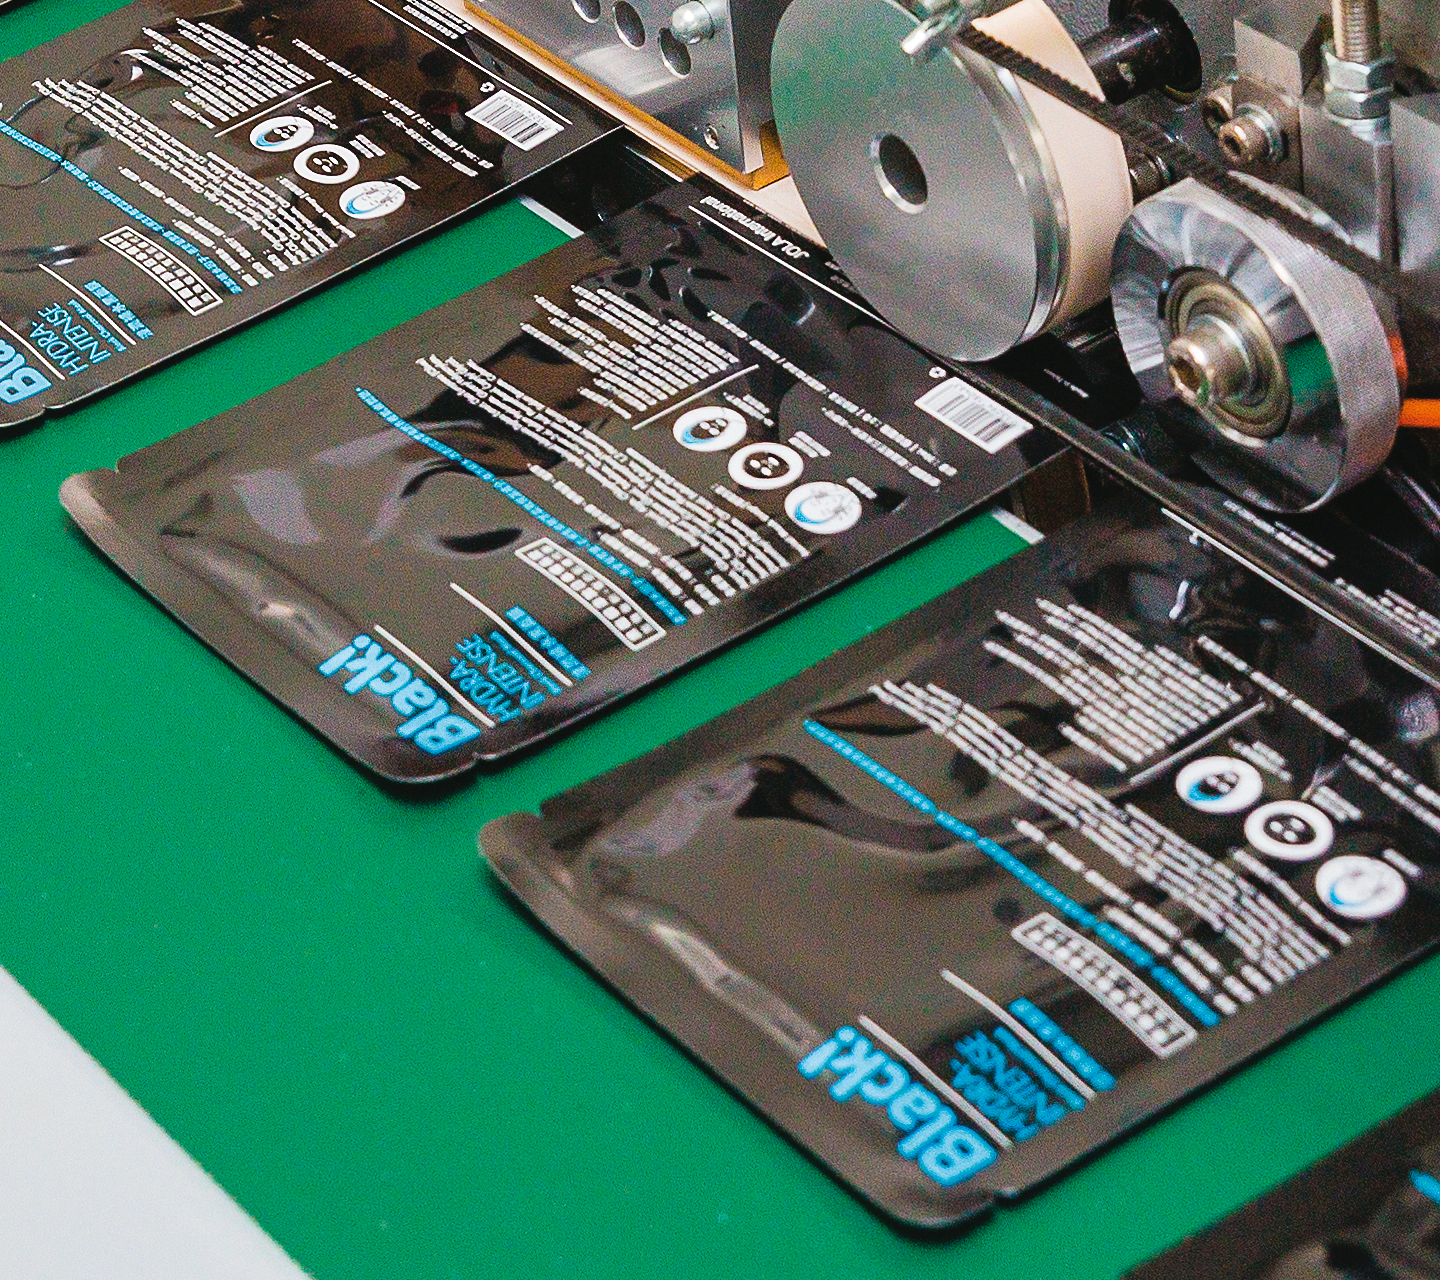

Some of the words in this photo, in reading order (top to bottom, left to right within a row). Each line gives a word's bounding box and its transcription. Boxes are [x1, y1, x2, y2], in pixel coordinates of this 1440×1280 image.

[699, 195, 777, 242] International
[771, 235, 810, 259] JOLA
[30, 321, 90, 377] HYDRA-
[38, 302, 112, 365] INTENSE
[317, 633, 483, 756] Black!
[449, 655, 523, 724] HYDRA-
[454, 633, 547, 712] INTENSE
[796, 1025, 1000, 1189] Black!
